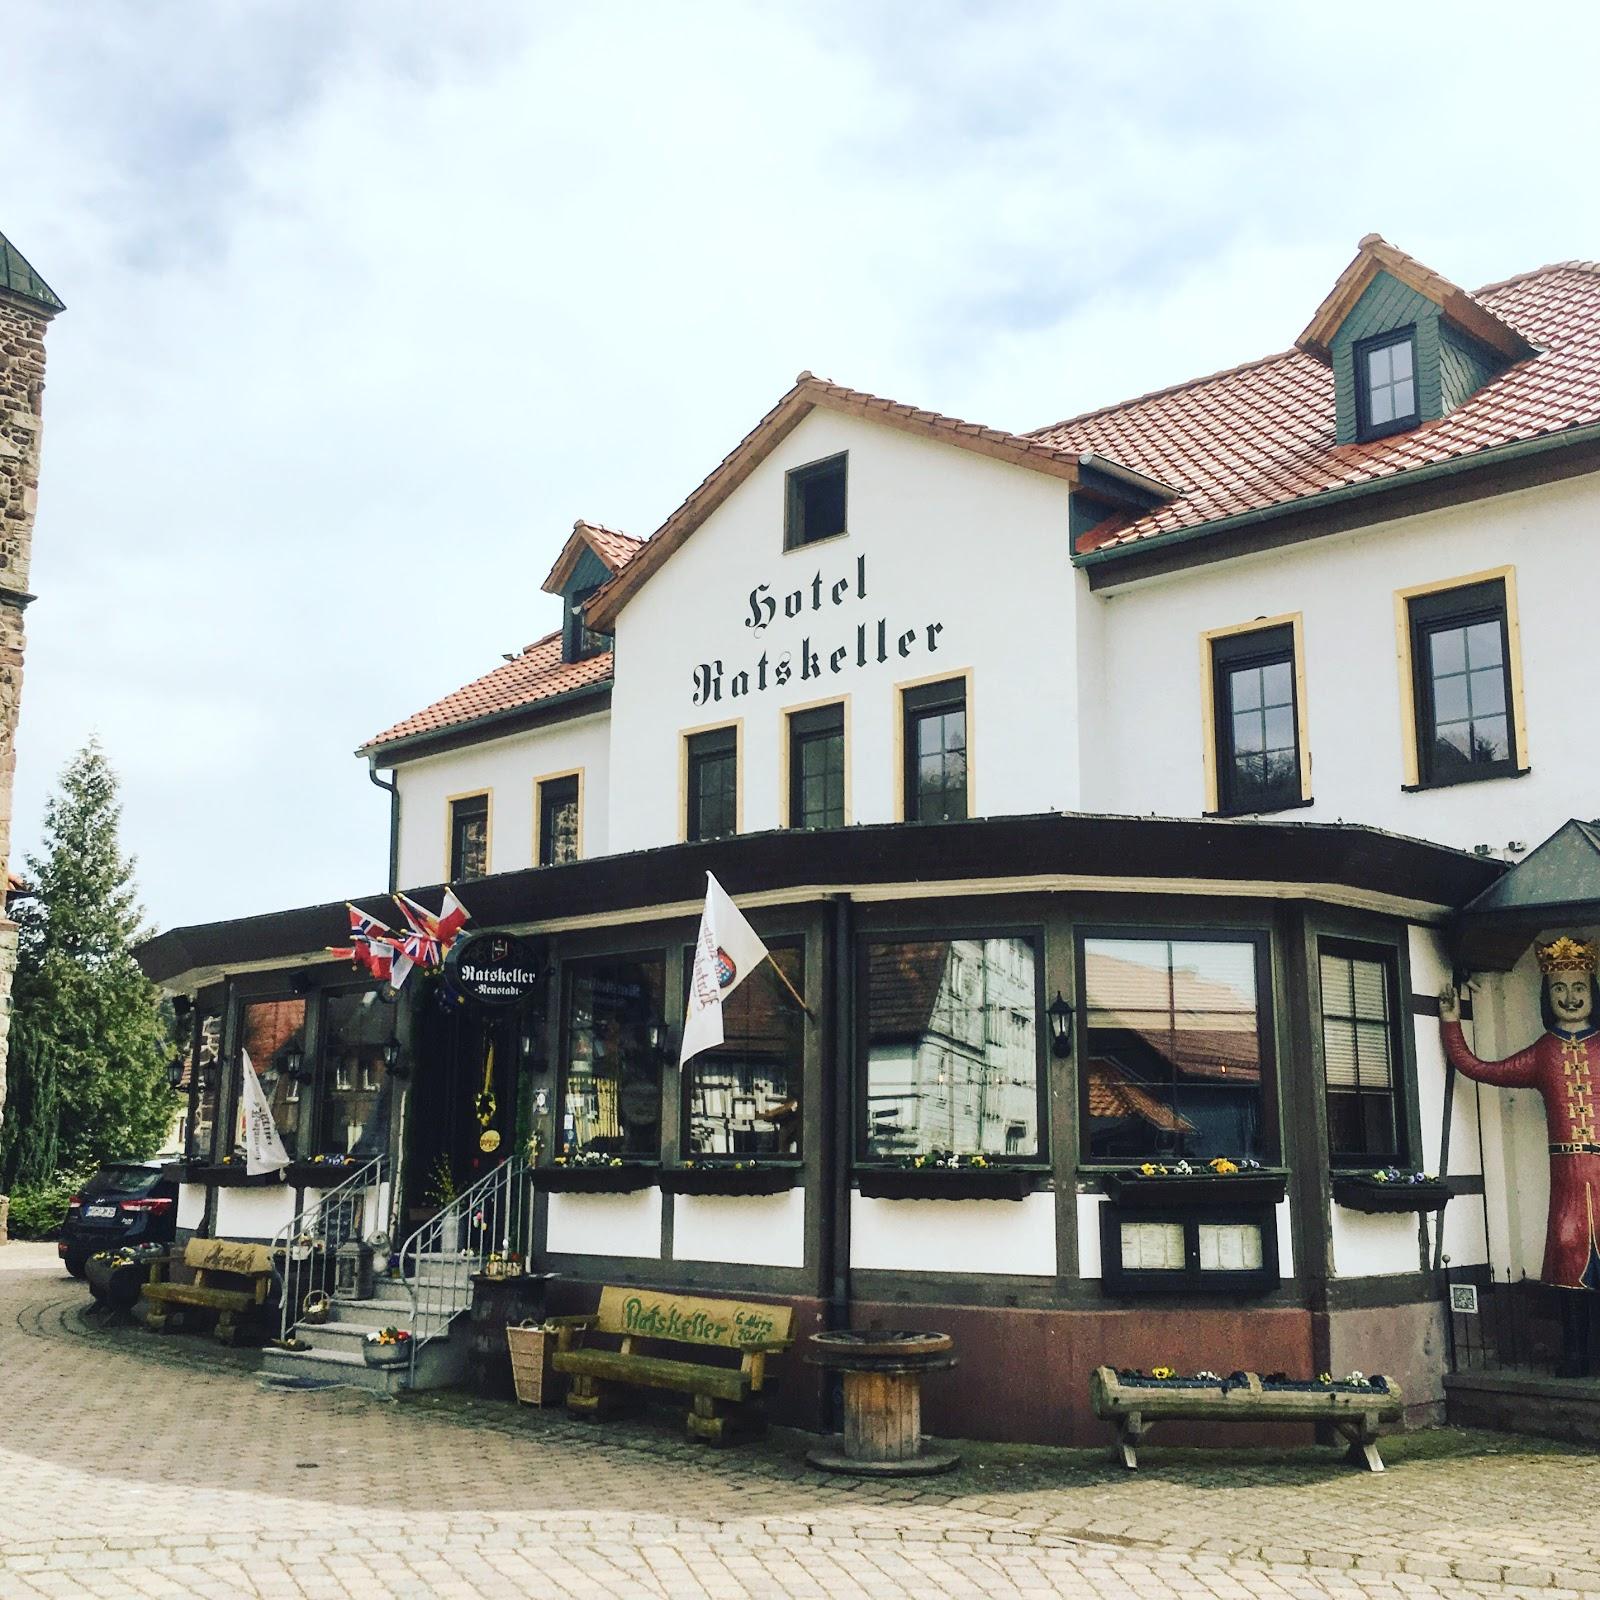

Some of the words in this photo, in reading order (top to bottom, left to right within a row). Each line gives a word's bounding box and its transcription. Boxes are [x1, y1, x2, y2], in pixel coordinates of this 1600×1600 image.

[745, 553, 867, 639] Hotel
[692, 617, 944, 707] Ratskeller
[461, 965, 536, 984] Ratskeller
[626, 1297, 728, 1339] Ratskeller
